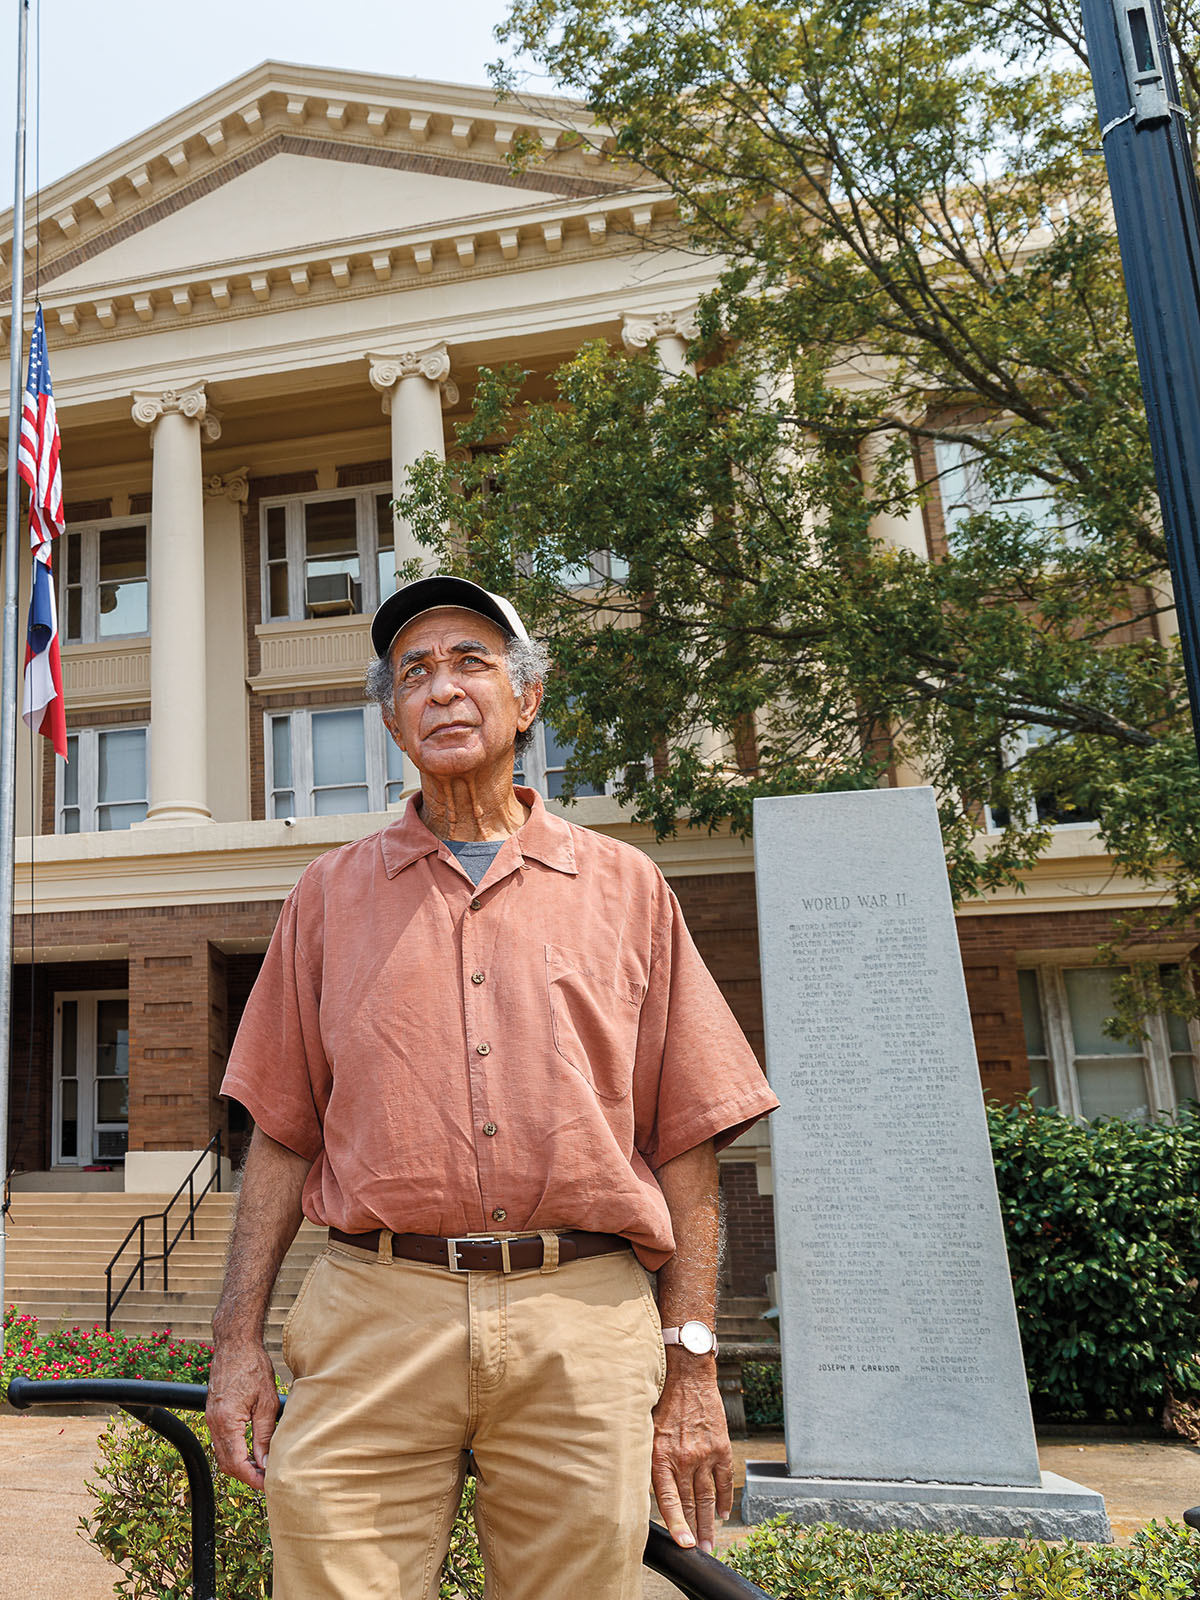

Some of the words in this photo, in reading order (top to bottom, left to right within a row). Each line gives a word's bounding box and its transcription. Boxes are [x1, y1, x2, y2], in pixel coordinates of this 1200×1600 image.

[802, 897, 850, 912] WORLD
[857, 894, 889, 909] WAR
[896, 892, 906, 906] II
[862, 1365, 900, 1373] GARRISON
